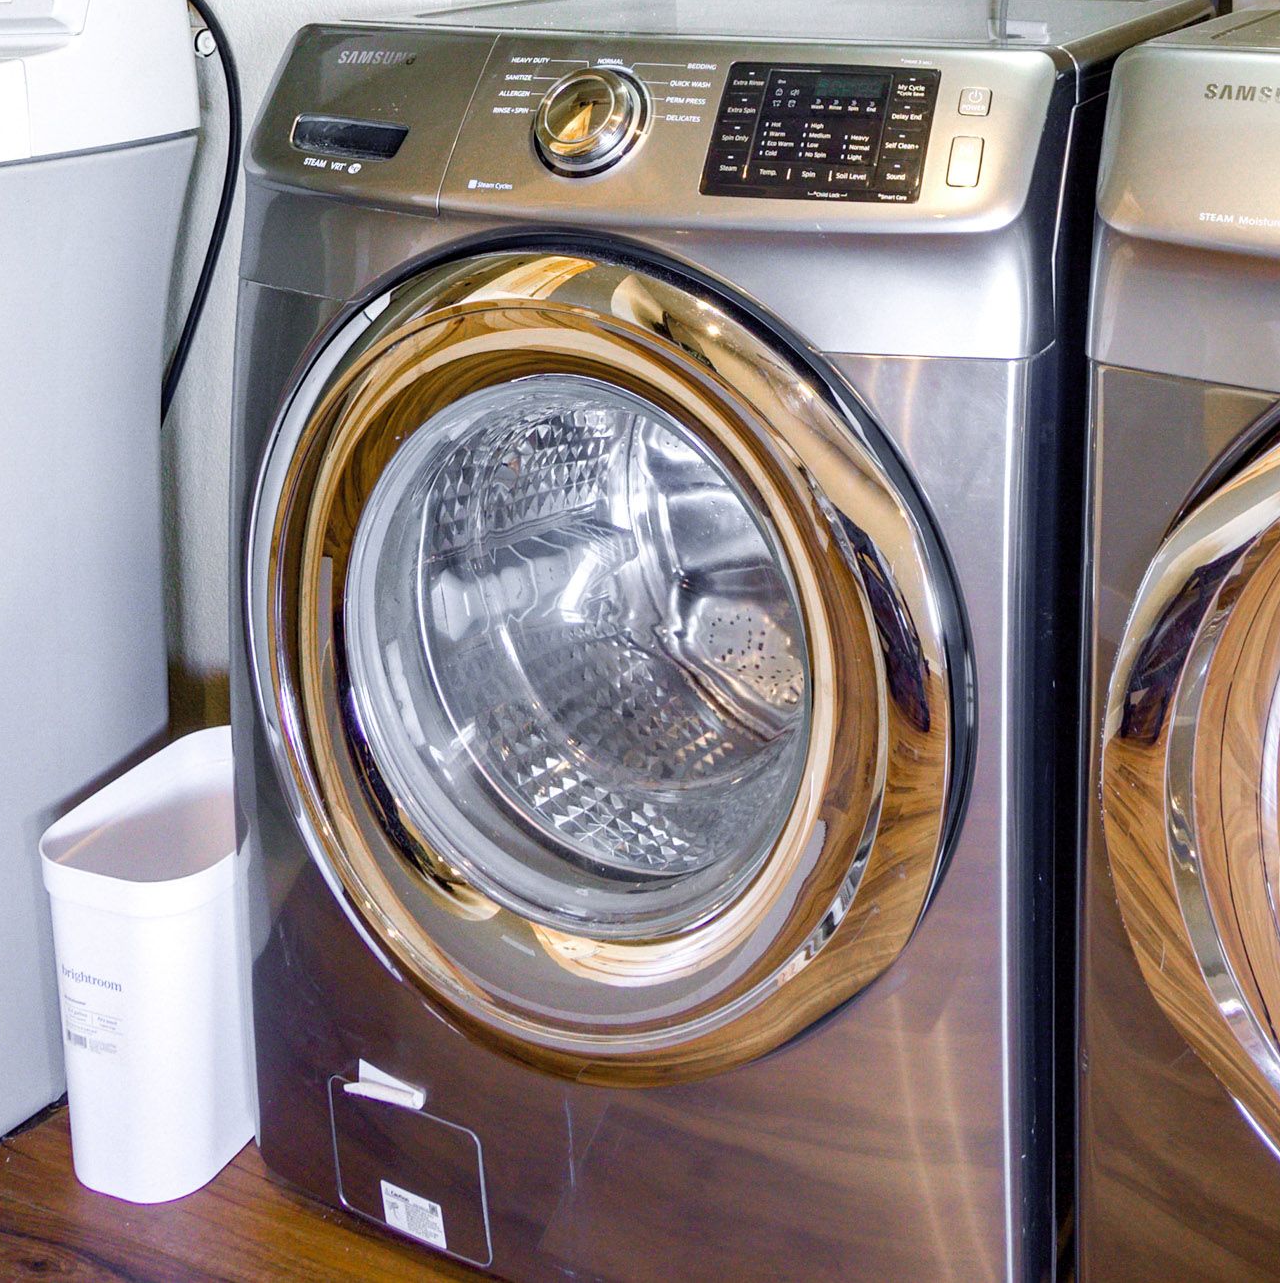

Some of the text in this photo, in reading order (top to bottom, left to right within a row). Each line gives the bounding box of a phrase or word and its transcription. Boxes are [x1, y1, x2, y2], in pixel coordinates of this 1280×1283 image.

[338, 50, 417, 66] SAMSUNG
[669, 80, 690, 88] QUICK
[743, 107, 756, 115] Spin
[666, 115, 701, 123] DELICATES
[891, 113, 909, 121] Delay
[721, 135, 749, 143] Spin Only
[850, 134, 870, 142] Heavy
[303, 157, 327, 168] STEAM
[719, 164, 738, 172] Steam
[801, 171, 816, 179] Spin
[849, 172, 867, 180] Level
[886, 173, 906, 181] Sound
[477, 181, 513, 190] Steam Cycles
[1199, 212, 1234, 223] STEAM
[61, 963, 122, 992] brightroom
